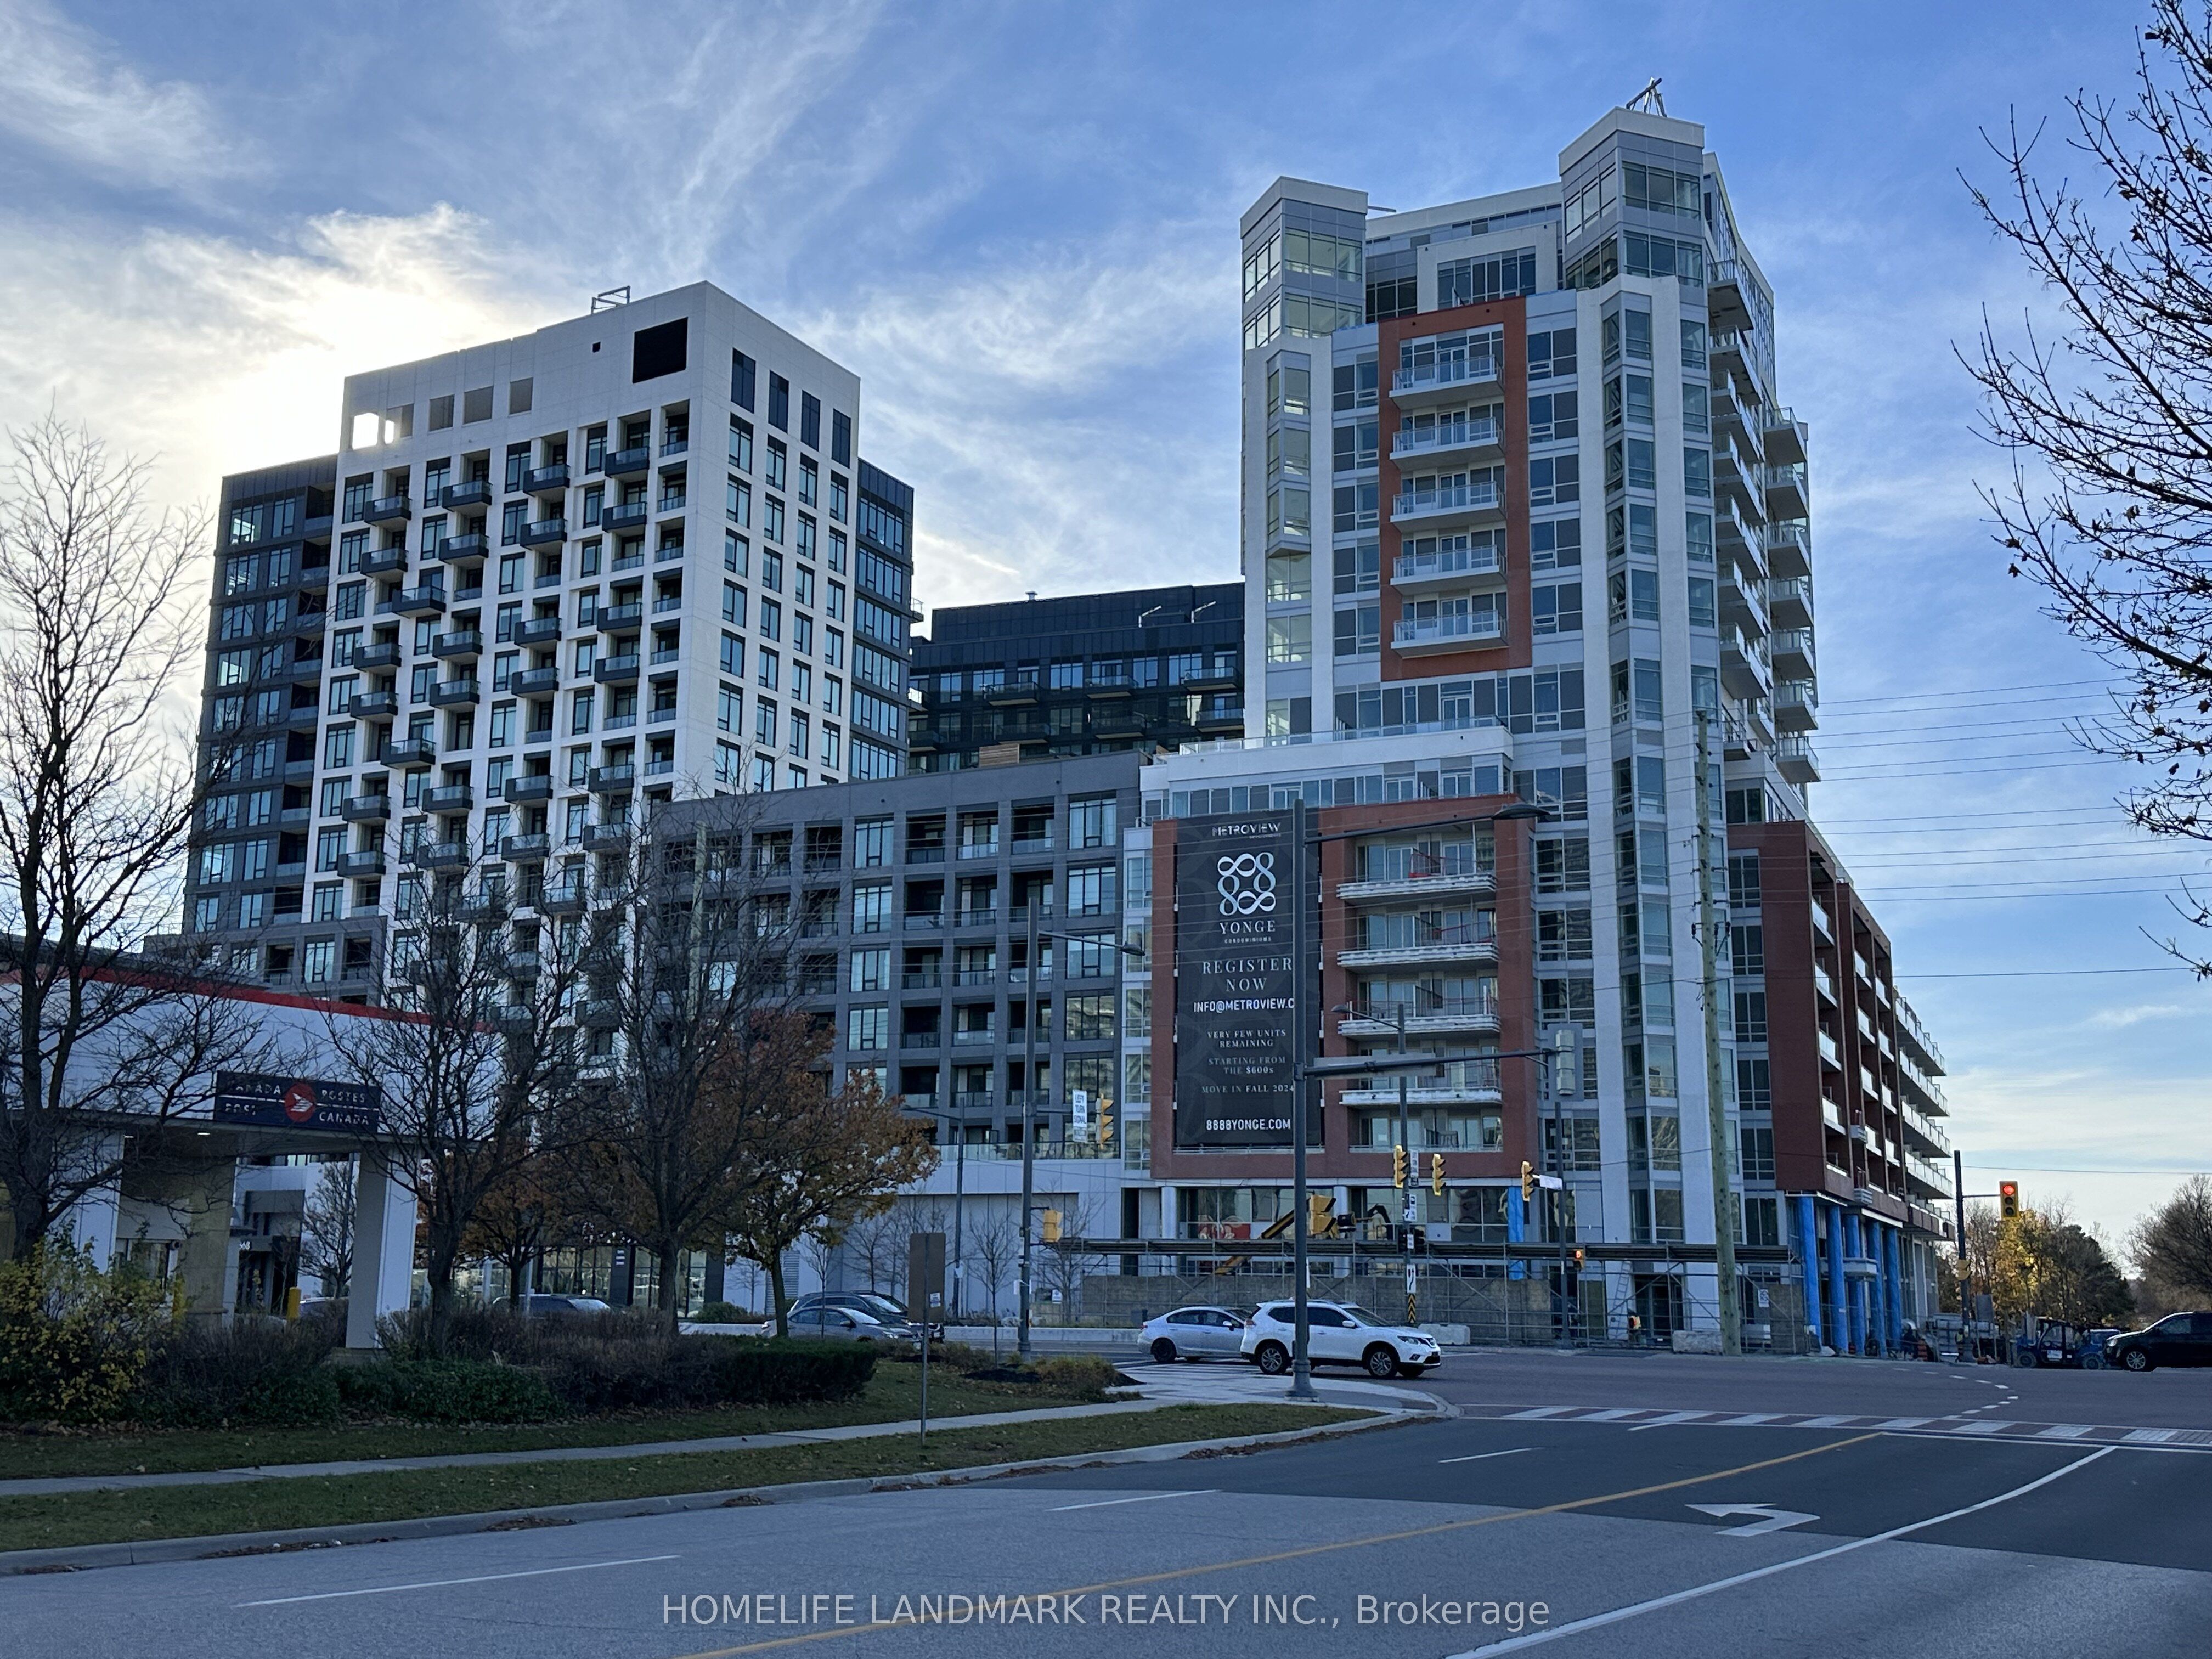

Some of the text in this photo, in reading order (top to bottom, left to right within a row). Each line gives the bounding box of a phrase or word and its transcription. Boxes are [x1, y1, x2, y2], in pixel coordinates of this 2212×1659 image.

[1212, 822, 1280, 837] METROVIEW
[1220, 920, 1276, 934] YONGE
[1203, 957, 1293, 974] REGISTER
[1226, 977, 1267, 992] NOW
[1234, 1030, 1253, 1038] FEW
[1220, 1039, 1273, 1048] REMAINING
[1209, 1056, 1286, 1065] STARTING FROM
[1246, 1066, 1274, 1074] $600s
[1201, 1085, 1228, 1093] MOVE
[319, 1111, 369, 1125] CANADA
[1205, 1119, 1291, 1131] 8888YONGE.COM
